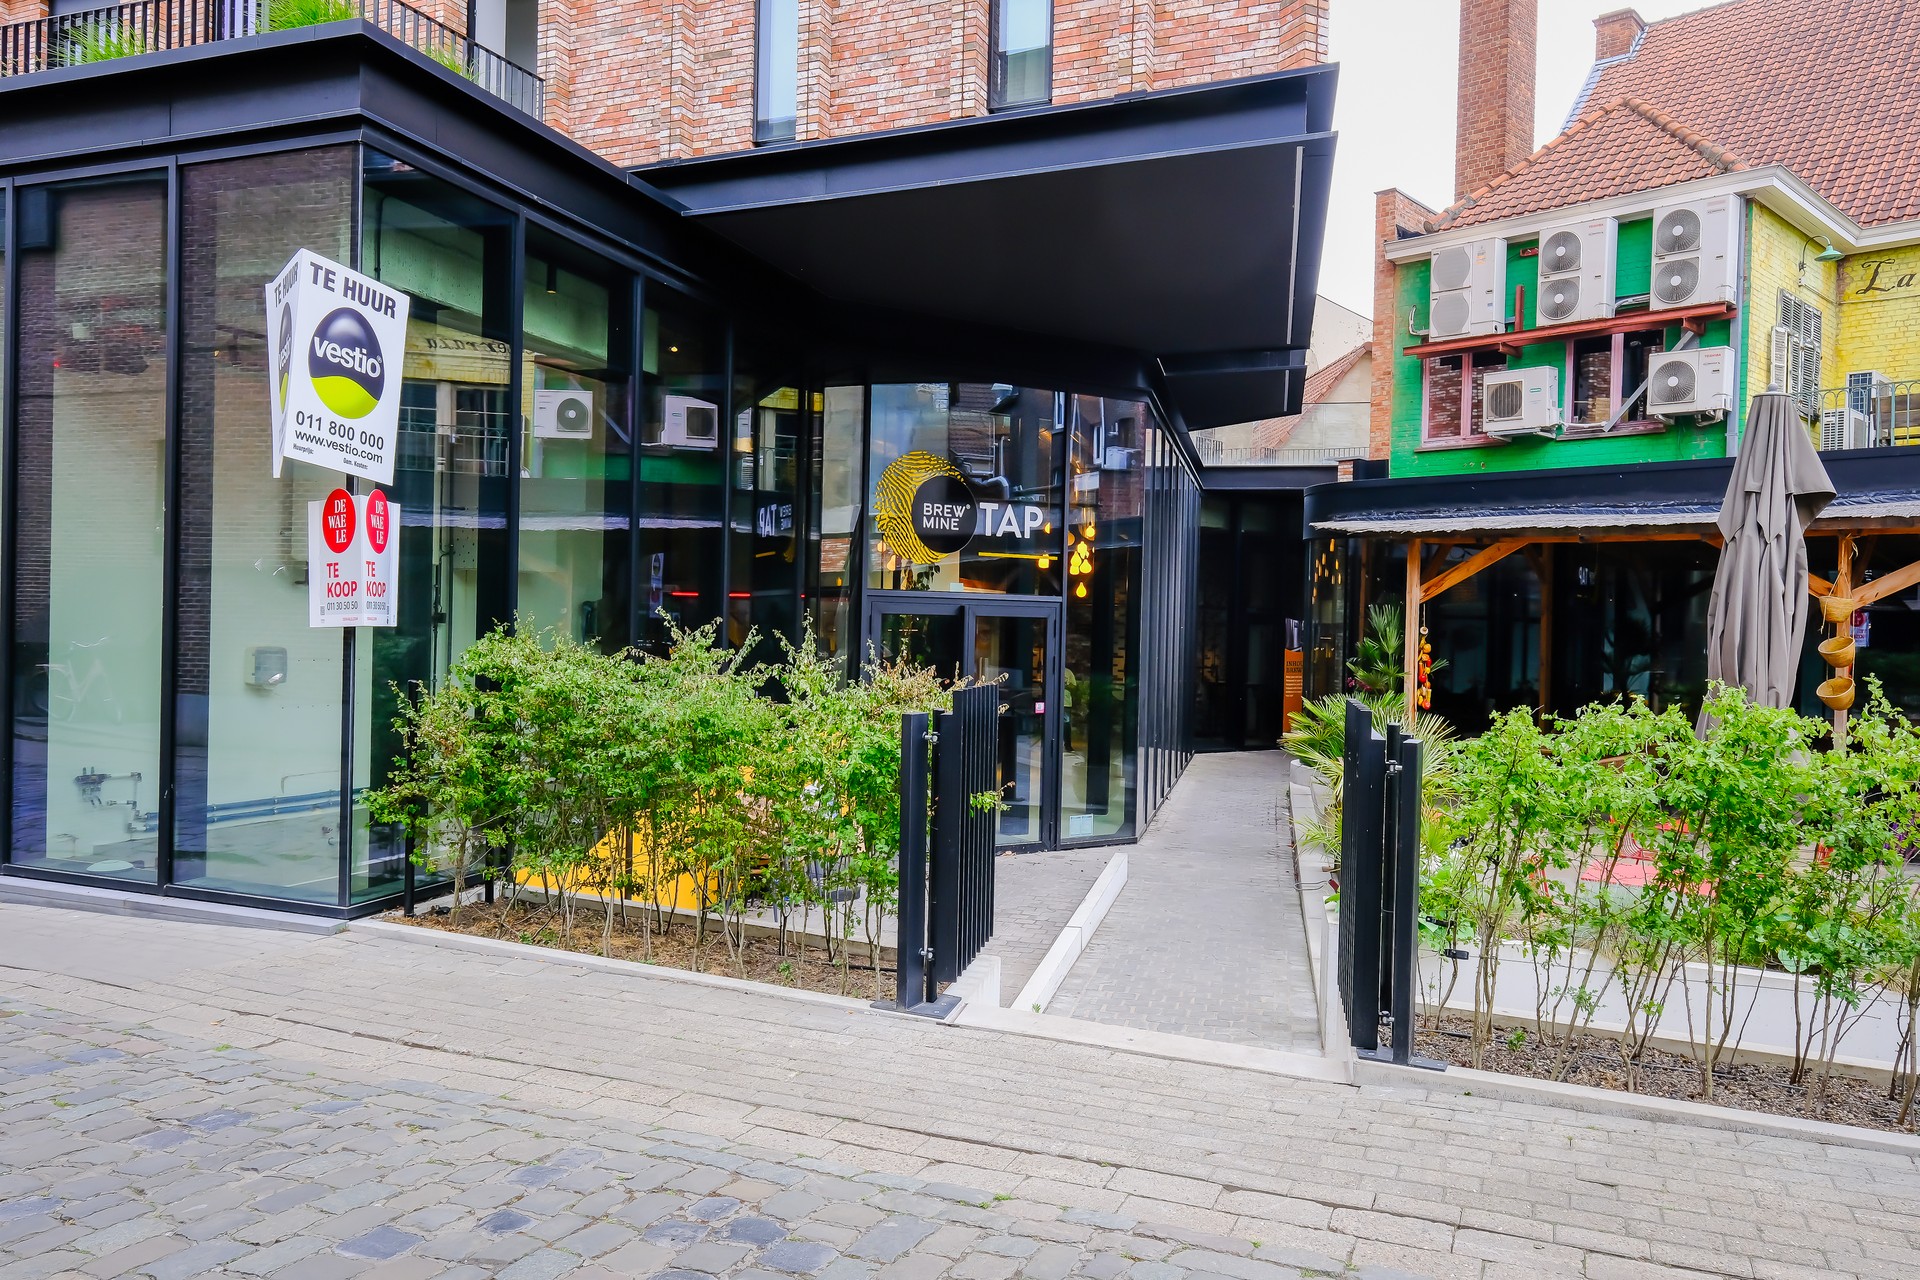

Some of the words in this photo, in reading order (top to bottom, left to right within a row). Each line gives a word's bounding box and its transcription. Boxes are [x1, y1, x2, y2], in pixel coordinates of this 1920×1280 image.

[274, 284, 282, 308] TE
[282, 261, 298, 300] HUUR
[1856, 258, 1917, 295] La
[309, 261, 336, 292] TE
[343, 279, 396, 319] HUUR
[313, 336, 381, 378] vestio
[296, 410, 322, 431] 011
[328, 420, 355, 441] 800
[360, 430, 384, 451] 000
[294, 430, 383, 464] www.vestio.com
[334, 499, 346, 513] DE
[375, 501, 384, 514] DE
[923, 502, 965, 517] BREW
[328, 514, 346, 529] WAE
[371, 514, 384, 529] WAE
[922, 517, 960, 531] MINE
[979, 502, 1044, 539] TAP
[336, 530, 346, 543] LE
[376, 530, 384, 545] LE
[326, 562, 339, 579] TE
[365, 560, 376, 577] TE
[326, 581, 357, 599] KOOP
[366, 581, 386, 598] KOOP
[327, 602, 335, 611] 011
[336, 602, 343, 611] 30
[343, 601, 350, 610] 50
[351, 601, 358, 610] 50
